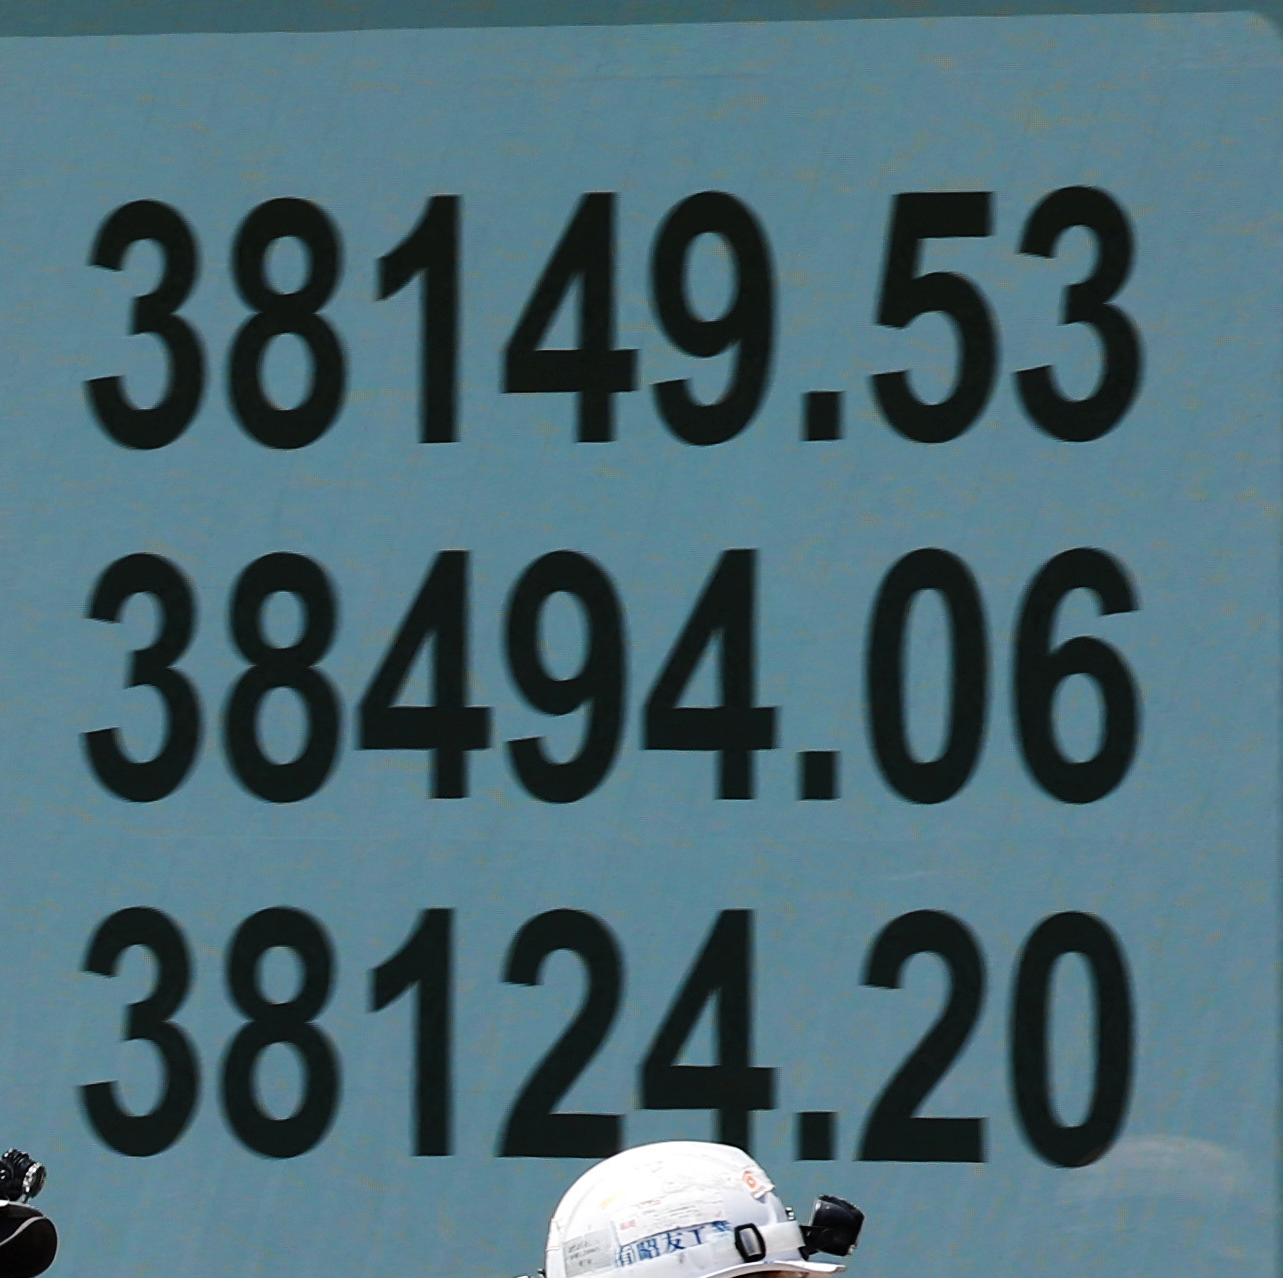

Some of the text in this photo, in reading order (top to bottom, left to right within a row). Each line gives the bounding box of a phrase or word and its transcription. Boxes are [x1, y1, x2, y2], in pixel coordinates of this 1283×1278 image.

[84, 185, 1144, 451] 38149.53
[82, 547, 1141, 804] 38494.06
[78, 906, 1134, 1168] 38124.20
